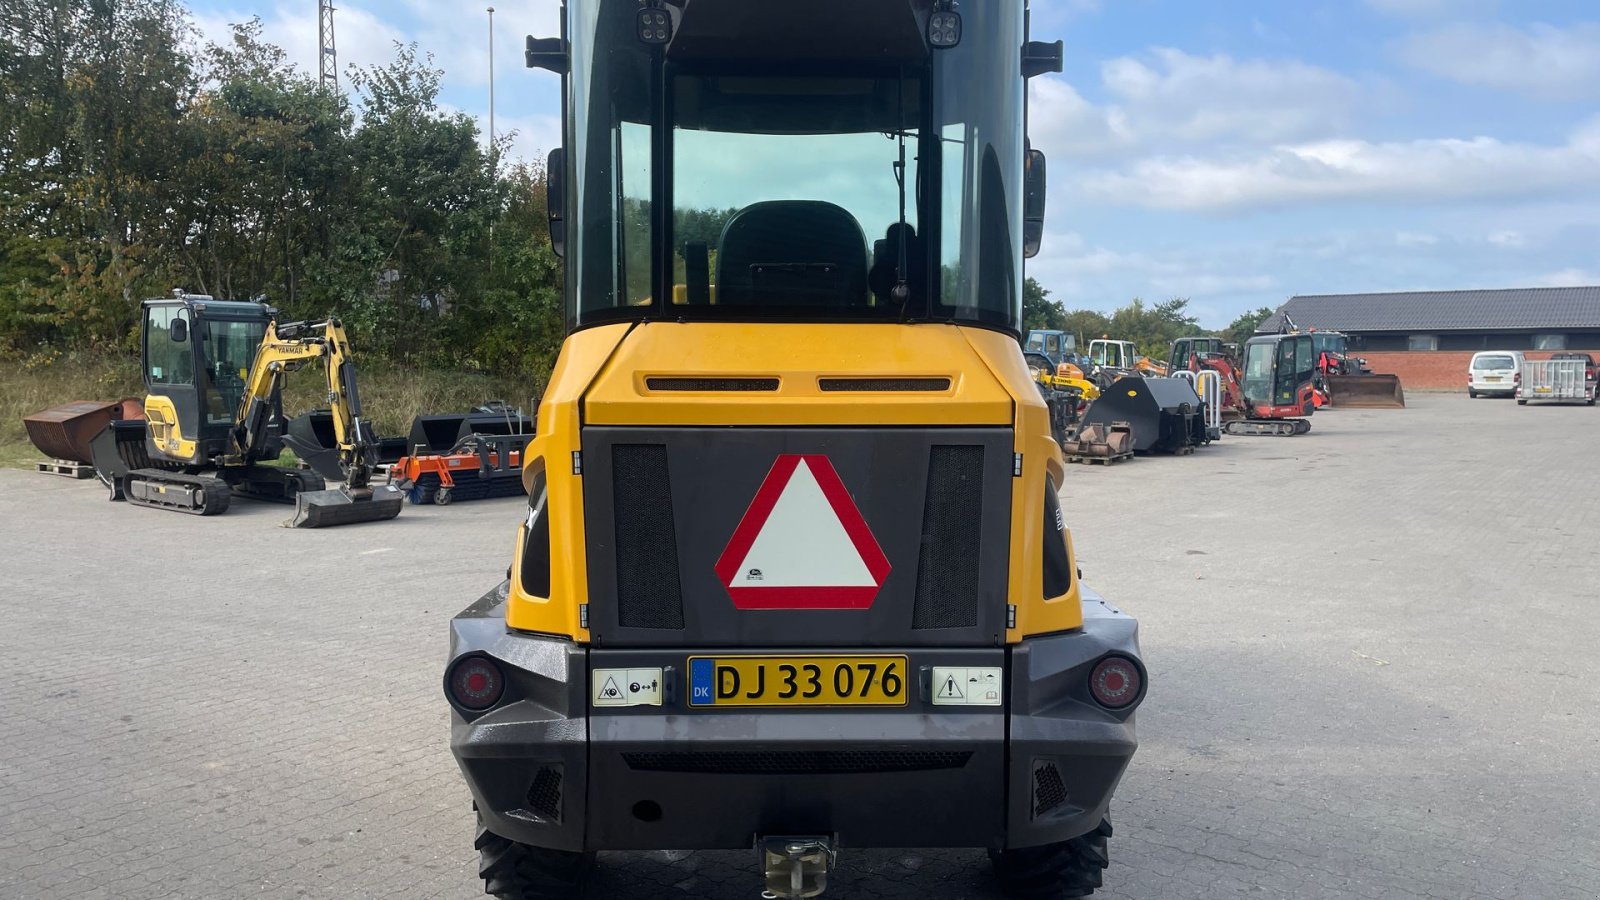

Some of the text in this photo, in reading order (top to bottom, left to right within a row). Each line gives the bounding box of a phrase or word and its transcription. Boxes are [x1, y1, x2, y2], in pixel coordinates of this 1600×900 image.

[277, 346, 303, 355] YANMAR
[777, 664, 823, 699] 33
[832, 661, 903, 699] 076
[693, 686, 709, 698] DK
